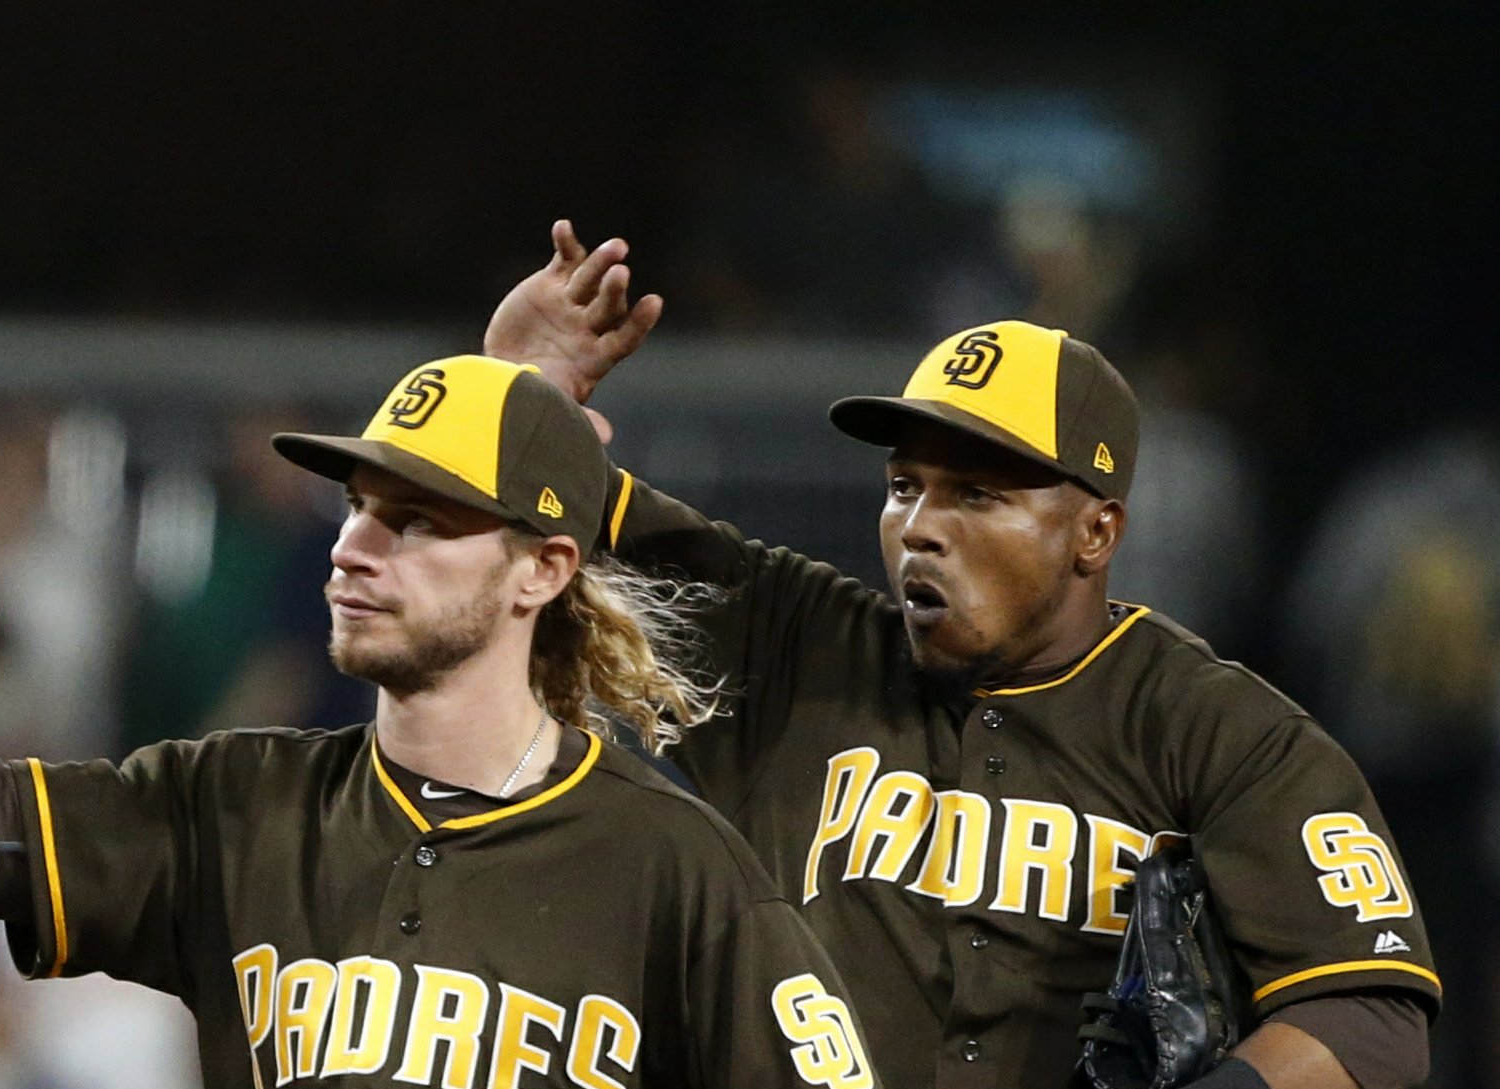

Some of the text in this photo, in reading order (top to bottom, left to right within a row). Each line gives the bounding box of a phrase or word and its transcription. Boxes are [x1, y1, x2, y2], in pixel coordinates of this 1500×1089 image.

[387, 368, 447, 430] SD
[943, 331, 1003, 390] SD
[802, 746, 1191, 936] PADRE
[1302, 812, 1413, 922] SD
